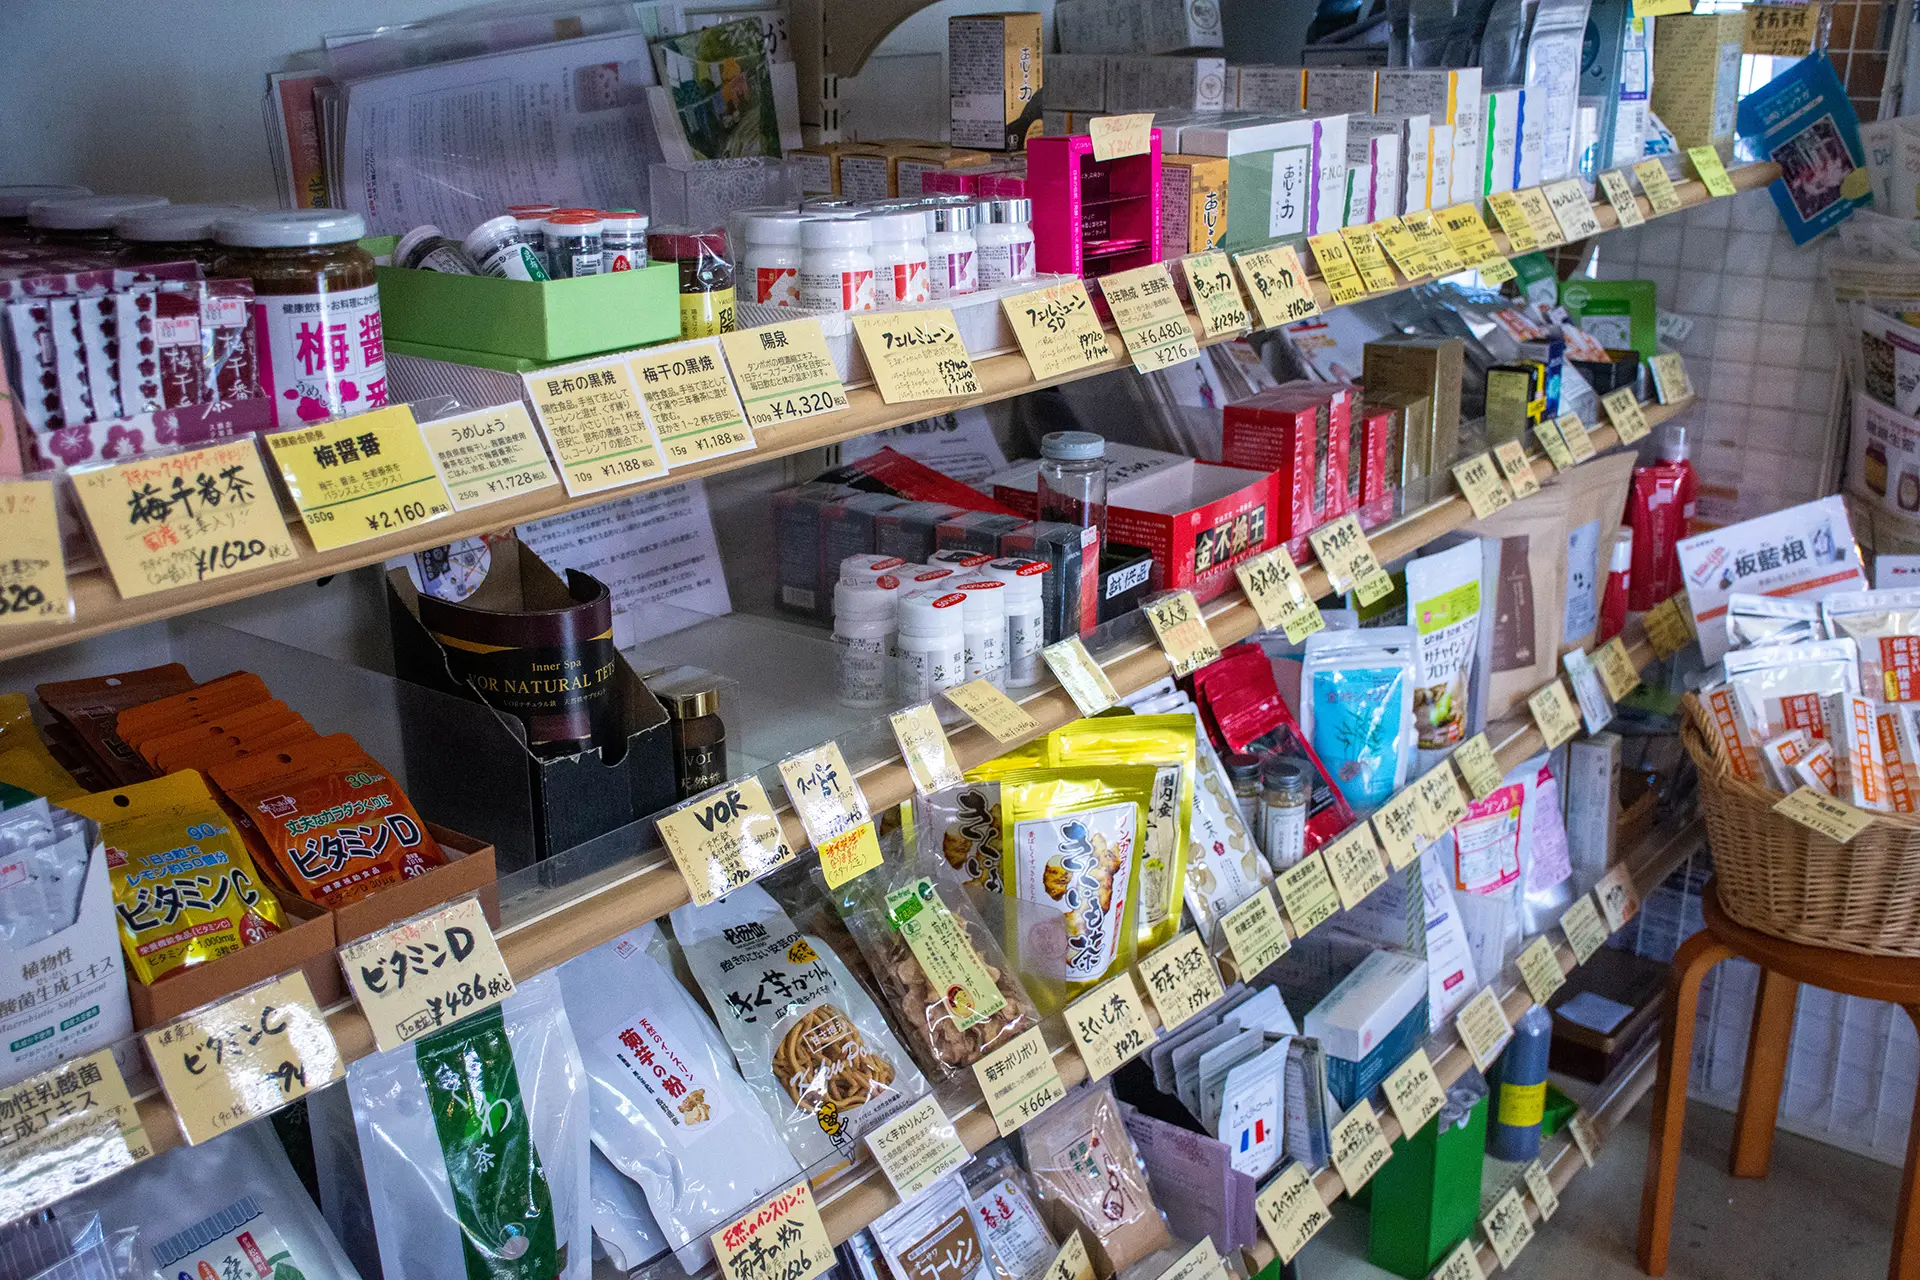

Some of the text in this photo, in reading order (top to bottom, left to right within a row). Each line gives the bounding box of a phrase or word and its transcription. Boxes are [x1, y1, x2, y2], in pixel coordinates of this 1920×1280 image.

[1106, 285, 1140, 305] 3年熟成
[759, 330, 789, 350] 陽泉
[1138, 321, 1184, 346] ¥6,480
[642, 355, 716, 385] 梅干の黒焼
[1155, 343, 1188, 364] ¥216
[547, 370, 617, 397] 昆布の黒焼
[752, 413, 773, 425] 100g
[770, 391, 834, 420] ¥4,320
[451, 418, 506, 442] うめしょう
[670, 445, 688, 457] 15g
[695, 432, 733, 451] ¥1,188
[313, 432, 383, 471] 梅醤番
[458, 489, 480, 502] 250g
[486, 472, 533, 493] ¥1,728
[575, 472, 593, 483] 10g
[601, 458, 641, 477] ¥1,188
[305, 511, 335, 525] 350g
[365, 501, 426, 532] ¥2,160
[1735, 540, 1808, 579] 板藍根
[531, 657, 582, 673] Inner Spa
[504, 673, 592, 695] NATURAL
[287, 793, 394, 837] 丈夫なカラダづくりに
[693, 791, 749, 834] VOR
[139, 845, 204, 868] 1日3粒で
[288, 814, 423, 880] ビタミンD
[126, 851, 230, 889] レモン約50個分
[322, 866, 381, 895] 健康補助食品
[116, 867, 261, 932] ビタミンC
[1059, 819, 1107, 973] きくいも茶
[138, 918, 233, 957] 栄養機能食品(ビタミンC)
[22, 947, 73, 980] 植物性
[361, 927, 476, 994] ビタミンD
[58, 982, 107, 1010] Supplement
[426, 974, 487, 1027] ¥486
[725, 961, 838, 1023] きく芋かりん
[1078, 992, 1130, 1044] きくいも茶
[639, 1018, 694, 1082] 天然のインスリン
[985, 1040, 1039, 1083] 菊芋ポリポリ
[1114, 1029, 1145, 1061] ¥432
[618, 1027, 688, 1099] 菊芋の粉
[1019, 1088, 1053, 1117] ¥664
[877, 1105, 936, 1150] きく芋かりんとう
[472, 1142, 496, 1175] 茶
[722, 1187, 806, 1252] 天然のインスリン!!
[729, 1219, 805, 1280] 菊芋の粉
[915, 1250, 938, 1270] オーサワ
[920, 1237, 974, 1280] コーレン
